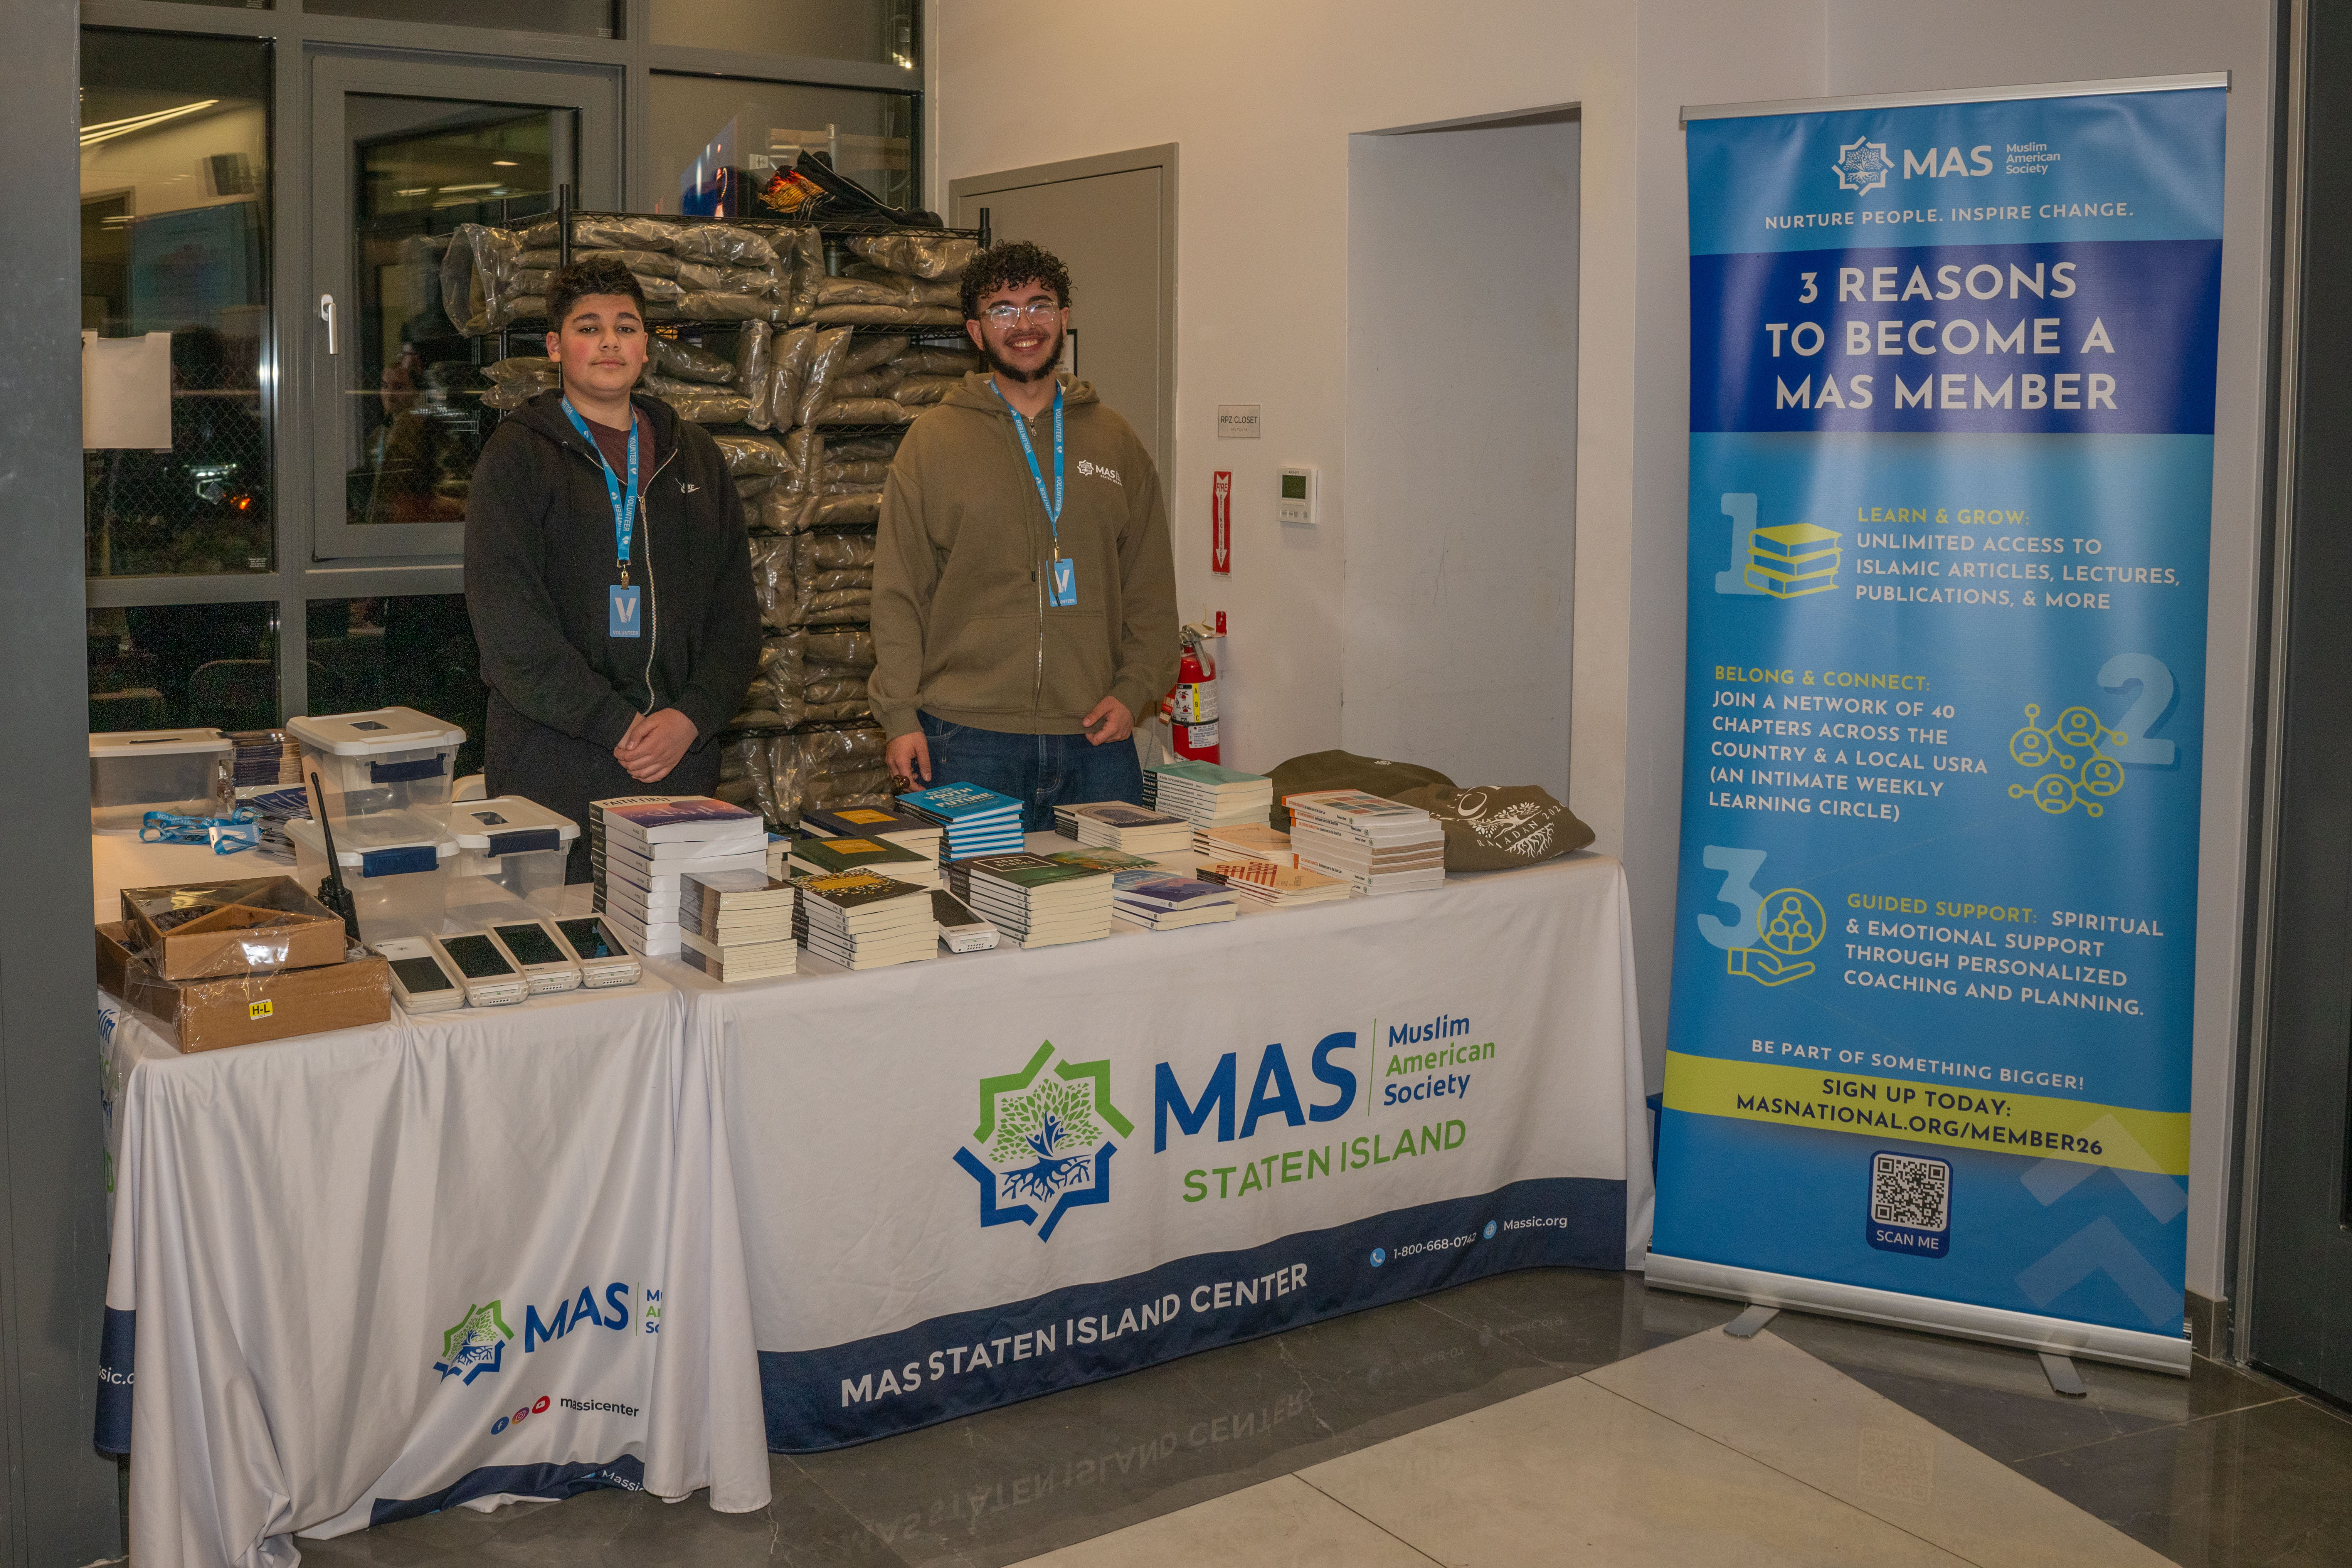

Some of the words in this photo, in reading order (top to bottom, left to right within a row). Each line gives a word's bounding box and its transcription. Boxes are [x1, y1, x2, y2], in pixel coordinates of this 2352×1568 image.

[1904, 145, 1993, 179] MAS
[2006, 153, 2060, 163] American
[2007, 142, 2047, 153] Muslim
[2006, 163, 2048, 175] Society
[1765, 212, 1854, 229] NURTURE
[1862, 209, 1943, 224] PEOPLE.
[1952, 206, 2031, 221] INSPIRE
[2040, 203, 2133, 218] CHANGE.
[1799, 273, 1817, 303] 3
[1840, 262, 2076, 303] REASONS
[1766, 322, 1824, 357] TO
[1846, 319, 2059, 356] BECOME
[2081, 317, 2115, 353] A
[1777, 375, 1873, 409] MAS
[1895, 373, 2118, 410] MEMBER
[1016, 419, 1031, 453] VOLUNTEER
[1095, 465, 1115, 478] MAS
[1216, 483, 1228, 492] FIRE
[623, 496, 635, 532] VOLUNTEER
[1858, 508, 1926, 522] LEARN
[1936, 509, 1948, 523] &
[1958, 510, 2029, 524] GROW:
[1857, 533, 1975, 551] UNLIMITED
[1983, 537, 2063, 552] ACCESS
[2073, 539, 2101, 554] TO
[1857, 559, 1939, 576] ISLAMIC
[1948, 562, 2053, 581] ARTICLES,
[2064, 565, 2179, 585] LECTURES,
[1856, 585, 2014, 607] PUBLICATIONS,
[2023, 591, 2036, 606] &
[2046, 592, 2110, 609] MORE
[1716, 666, 1793, 684] BELONG
[1803, 671, 1814, 685] &
[1824, 671, 1929, 690] CONNECT:
[1713, 691, 1755, 707] JOIN
[1763, 695, 1775, 709] A
[1784, 695, 1887, 714] NETWORK
[1896, 701, 1923, 716] OF
[1932, 705, 1954, 718] 40
[1713, 717, 1812, 736] CHAPTERS
[1819, 723, 1899, 741] ACROSS
[1908, 728, 1947, 744] THE
[1712, 742, 1807, 761] COUNTRY
[1814, 748, 1826, 762] &
[1835, 750, 1847, 764] A
[1856, 750, 1924, 769] LOCAL
[1934, 756, 1987, 773] USRA
[924, 787, 974, 801] YOUTH
[926, 787, 954, 796] OUR
[1711, 766, 1743, 783] (AN
[1752, 770, 1847, 789] INTIMATE
[1856, 777, 1943, 796] WEEKLY
[602, 797, 638, 806] FAITH
[935, 792, 994, 807] FUTURE
[941, 793, 969, 801] OUR
[1710, 792, 1811, 813] LEARNING
[1819, 800, 1899, 822] CIRCLE)
[1847, 893, 1927, 914] GUIDED
[1936, 902, 2037, 923] SUPPORT:
[2052, 911, 2163, 935] SPIRITUAL
[1846, 919, 1859, 933] &
[1868, 920, 1996, 947] EMOTIONAL
[2005, 934, 2104, 956] SUPPORT
[1846, 944, 1948, 968] THROUGH
[1958, 956, 2127, 986] PERSONALIZED
[1844, 970, 1957, 995] COACHING
[1965, 983, 2012, 1000] AND
[2021, 988, 2143, 1015] PLANNING.
[252, 1004, 270, 1015] H-L
[1389, 1014, 1469, 1047] Muslim
[1386, 1042, 1495, 1077] American
[1753, 1040, 1774, 1053] BE
[1782, 1043, 1831, 1060] PART
[1839, 1050, 1864, 1063] OF
[1872, 1053, 1991, 1079] SOMETHING
[2000, 1068, 2083, 1090] BIGGER!
[1154, 1032, 1356, 1154] MAS
[1384, 1074, 1470, 1105] Society
[1823, 1079, 1876, 1099] SIGN
[1887, 1087, 1915, 1104] UP
[1925, 1091, 2010, 1116] TODAY:
[1738, 1095, 2102, 1155] MASNATIONAL.ORG/MEMBER26
[1183, 1146, 1330, 1202] STATEN
[1341, 1120, 1465, 1172] ISLAND
[1504, 1216, 1567, 1230] Massic.org
[1877, 1230, 1913, 1245] SCAN
[1918, 1236, 1938, 1249] ME
[525, 1283, 629, 1353] MAS
[842, 1362, 921, 1407] MAS
[929, 1324, 1055, 1380] STATEN
[1067, 1294, 1180, 1345] ISLAND
[1191, 1263, 1307, 1312] CENTER
[561, 1398, 639, 1417] massicenter
